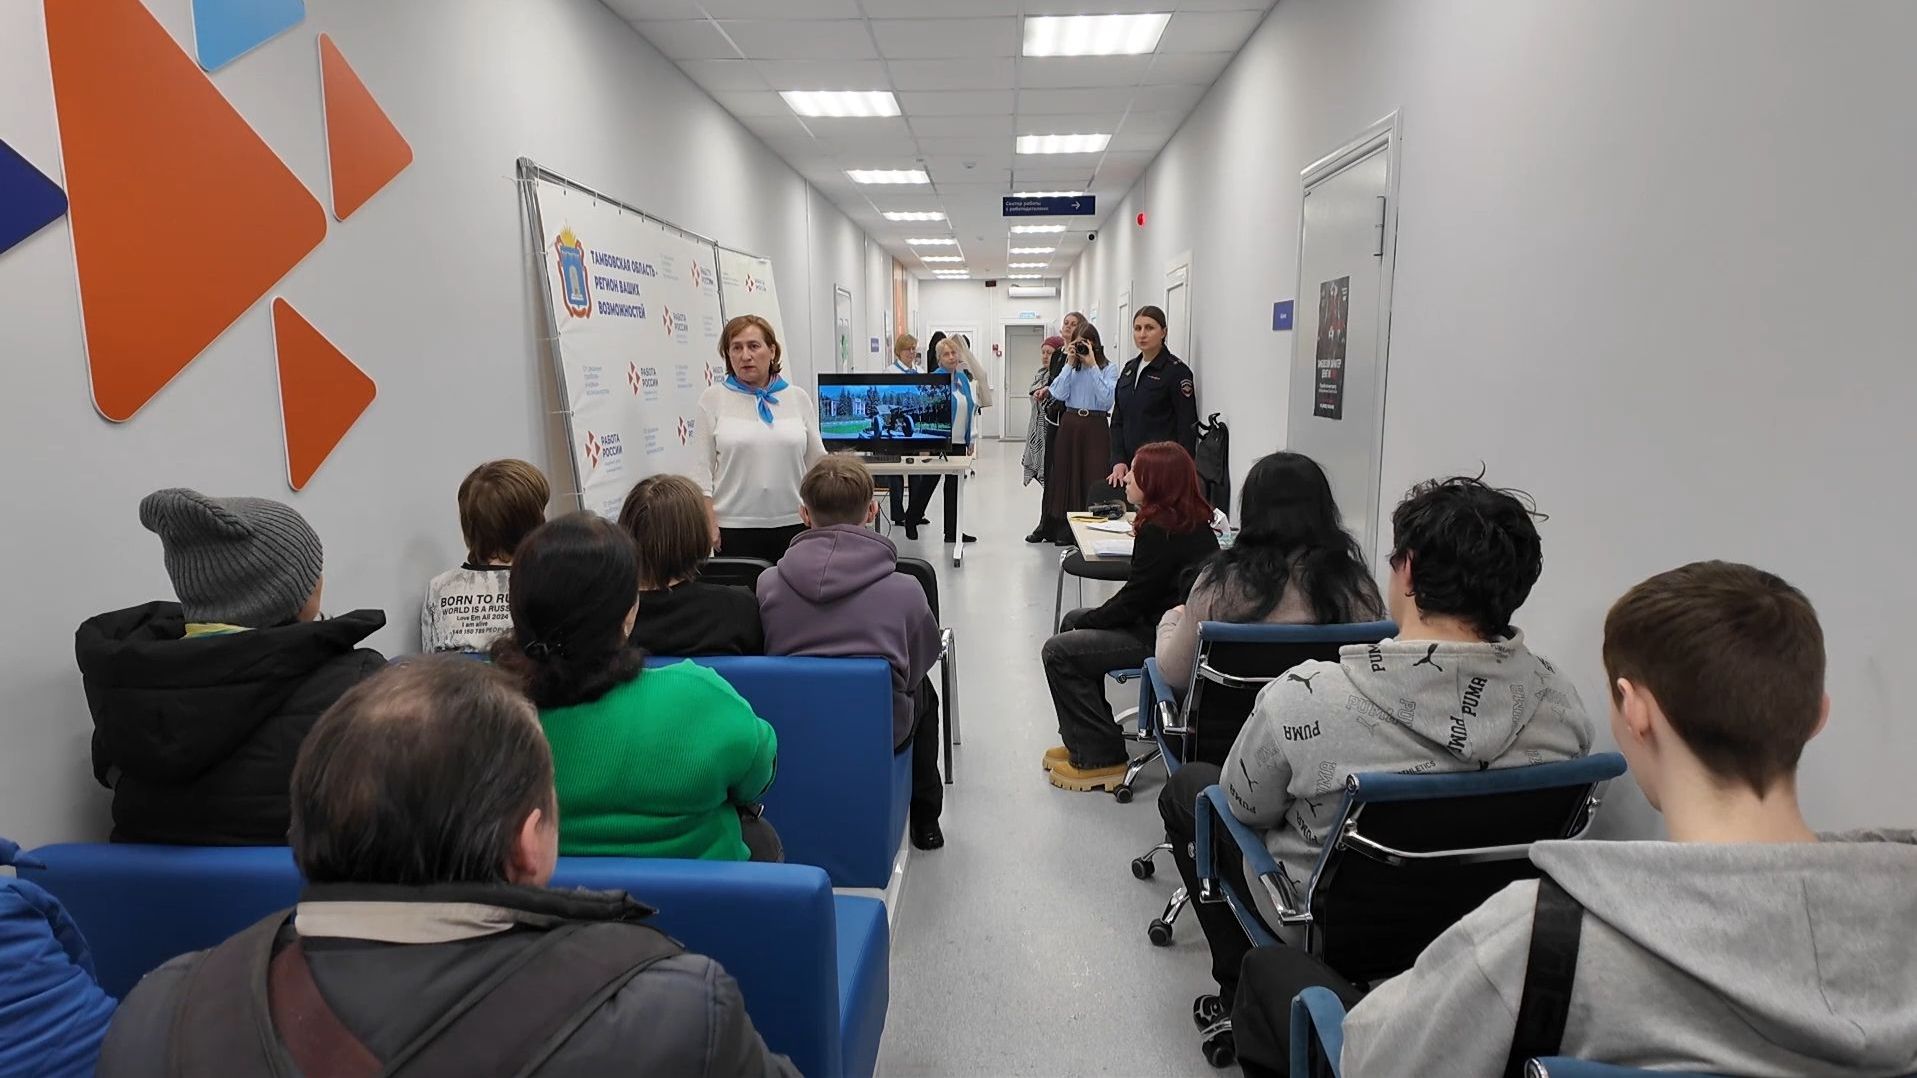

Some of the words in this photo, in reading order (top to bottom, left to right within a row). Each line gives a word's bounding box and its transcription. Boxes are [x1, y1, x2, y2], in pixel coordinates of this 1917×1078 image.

[590, 250, 631, 272] ТАМБОВСКАЯ
[594, 275, 619, 292] РЕГИОН
[619, 280, 640, 296] ВАШИХ
[598, 301, 646, 319] ВОЗМОЖНОСТЕЙ
[641, 367, 656, 376] РАБОТА
[642, 378, 658, 388] РОССИИ
[601, 433, 620, 445] РАБОТА
[602, 445, 622, 458] РОССИИ
[441, 595, 473, 608] BORN
[477, 594, 493, 605] TO
[496, 593, 510, 603] RU
[442, 606, 469, 615] WORLD
[1368, 645, 1386, 672] PUM
[1462, 676, 1488, 718] PUMA
[1283, 720, 1321, 741] PUMA
[1447, 715, 1468, 753] PUM
[1229, 783, 1257, 814] PUMA
[1296, 810, 1318, 843] PUMA
